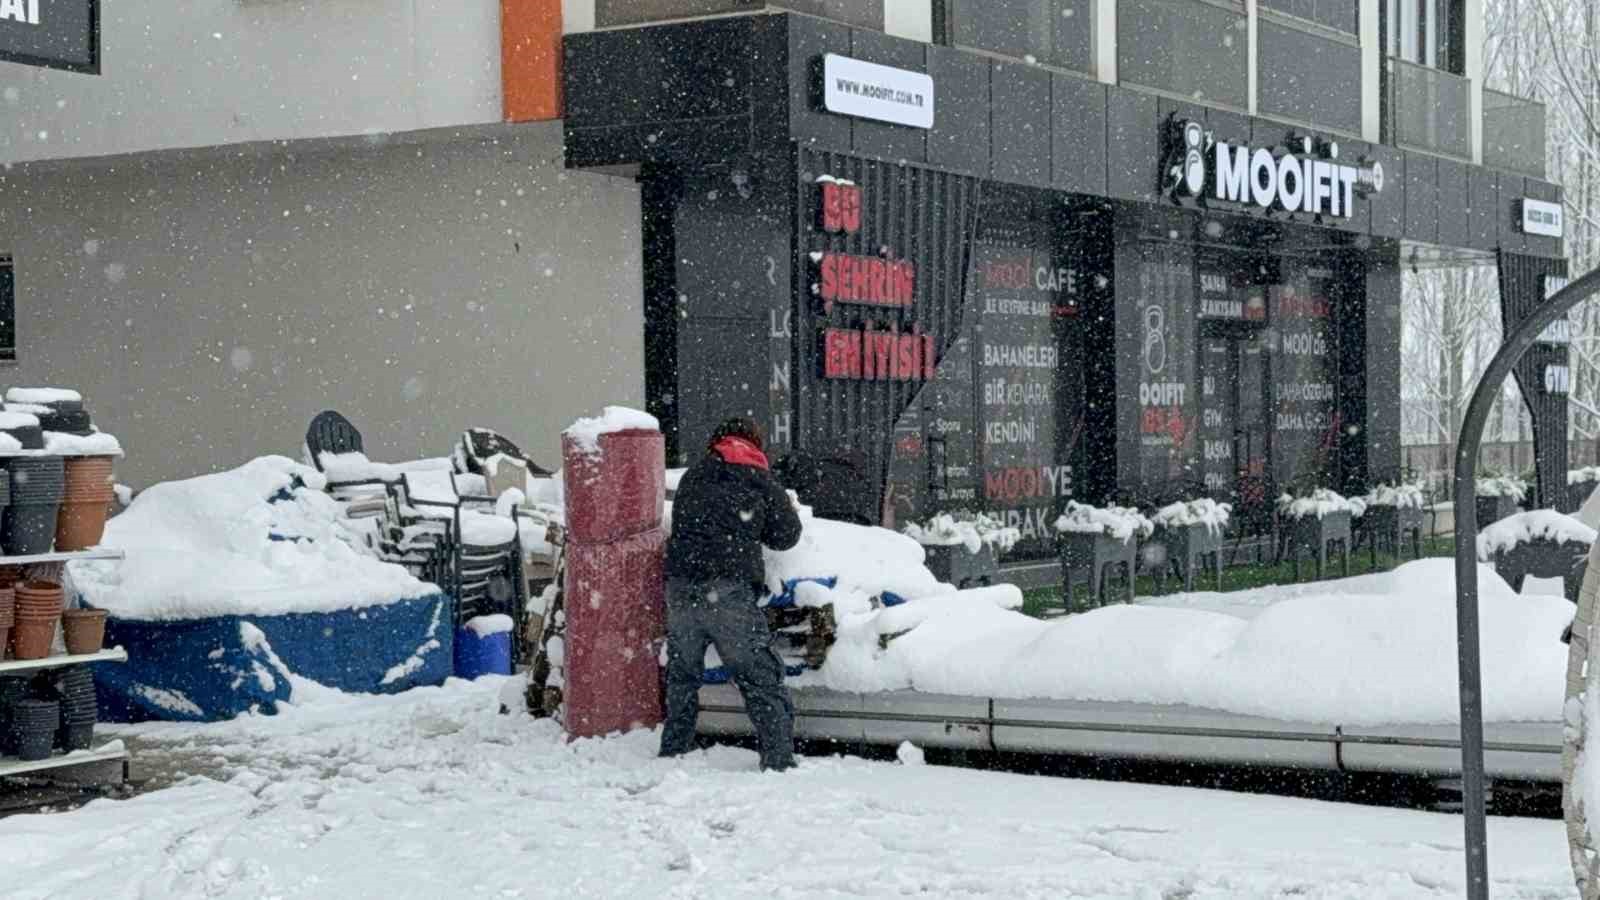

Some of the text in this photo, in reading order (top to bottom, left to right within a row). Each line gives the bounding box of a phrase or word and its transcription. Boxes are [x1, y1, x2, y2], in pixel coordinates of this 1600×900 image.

[1035, 266, 1078, 293] CAFE
[984, 341, 1058, 368] BAHANELERİ
[985, 415, 1036, 444] KENDİNİ
